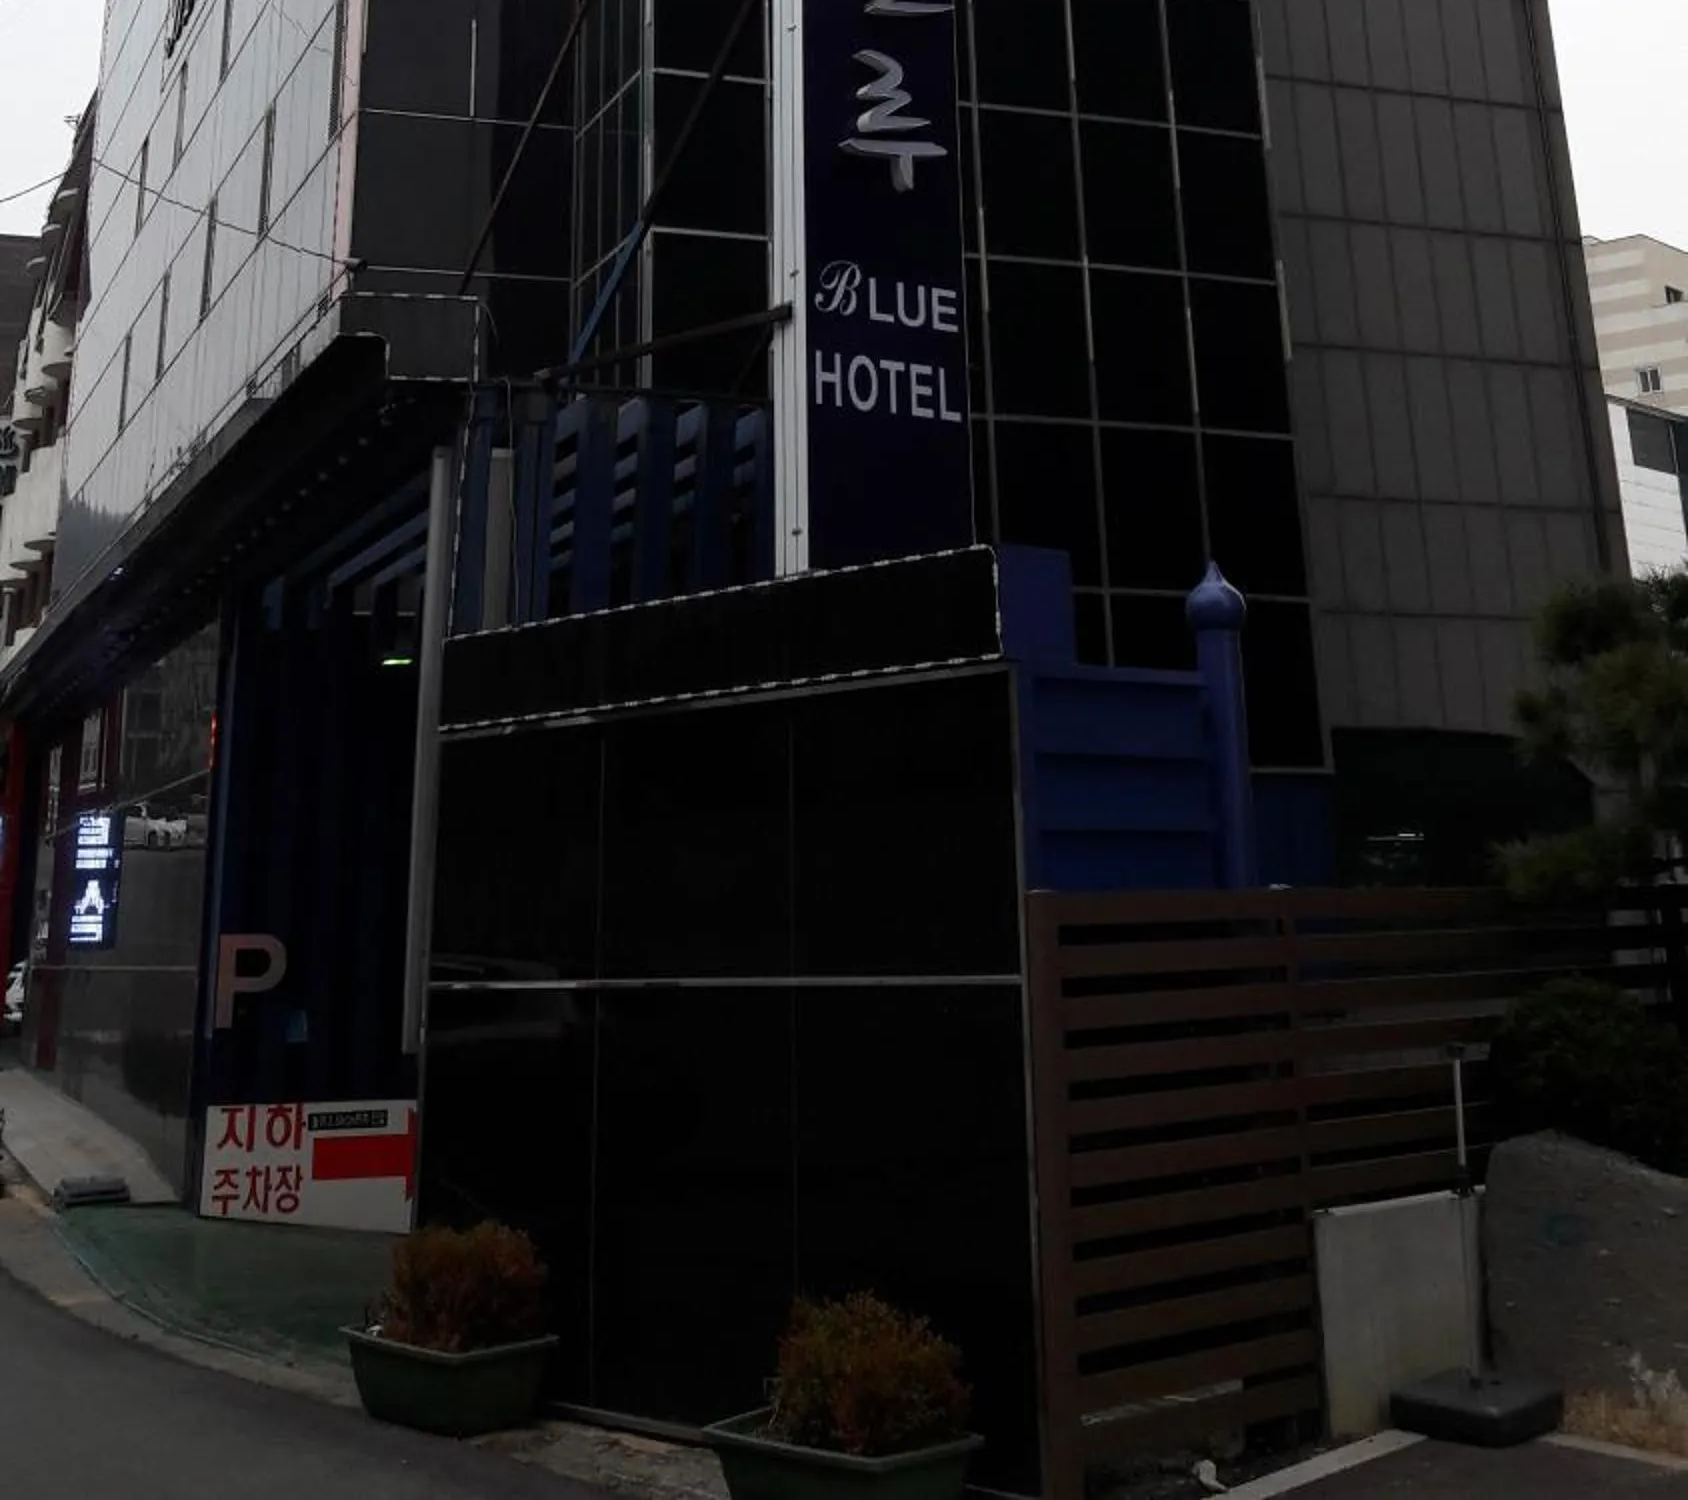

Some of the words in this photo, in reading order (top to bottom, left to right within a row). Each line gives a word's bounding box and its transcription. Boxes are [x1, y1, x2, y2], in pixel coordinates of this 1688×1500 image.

[813, 260, 959, 333] BLUE
[814, 350, 962, 423] HOTEL
[215, 933, 288, 1029] P
[216, 1104, 306, 1152] 지하
[211, 1165, 304, 1216] 주차장
